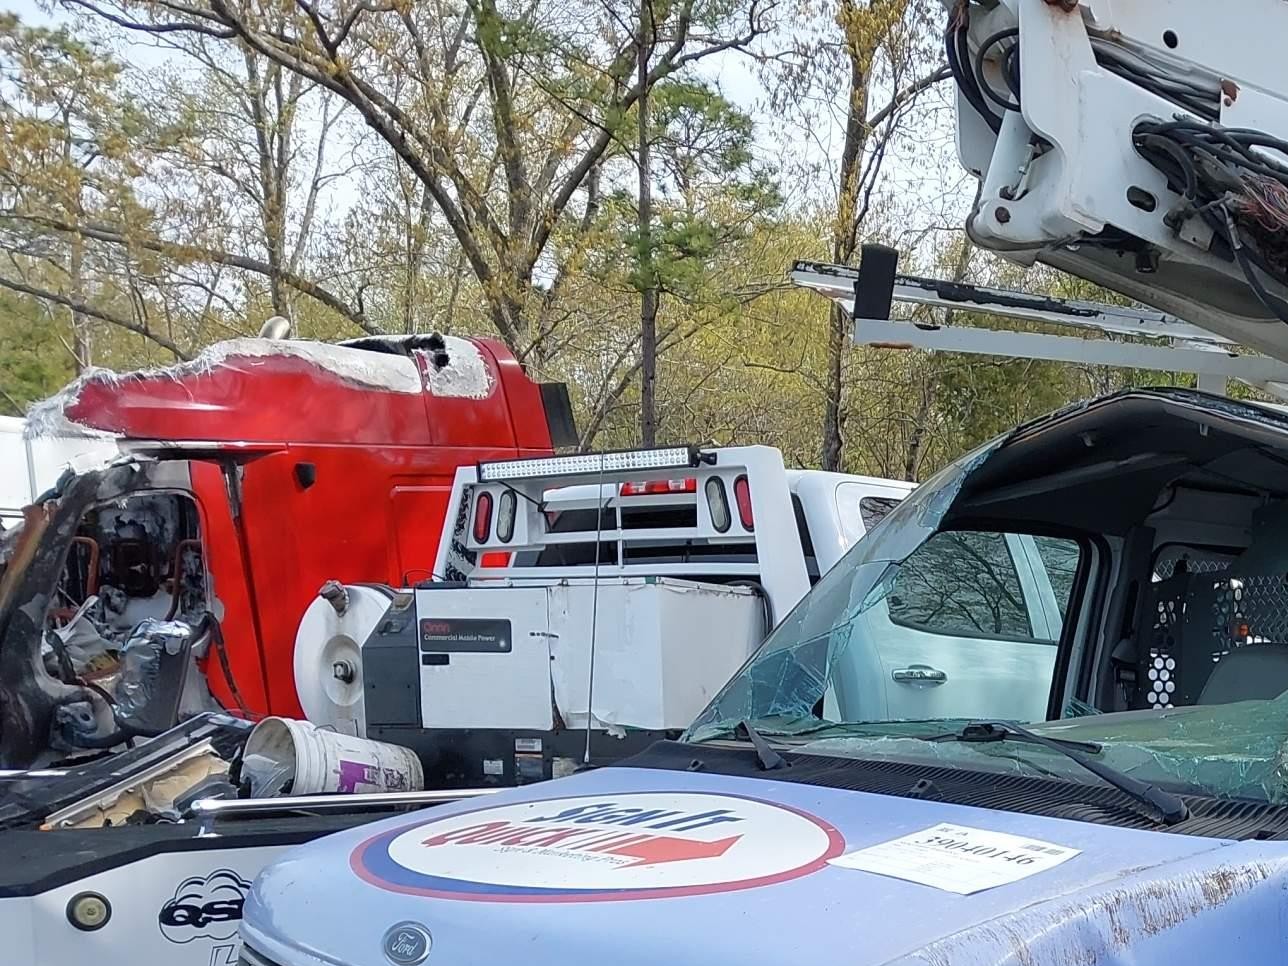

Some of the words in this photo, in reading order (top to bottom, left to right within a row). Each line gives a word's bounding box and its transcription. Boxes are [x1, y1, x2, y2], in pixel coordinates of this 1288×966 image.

[424, 633, 458, 641] Commercial
[914, 837, 1037, 865] 39040146
[392, 932, 418, 956] Ford
